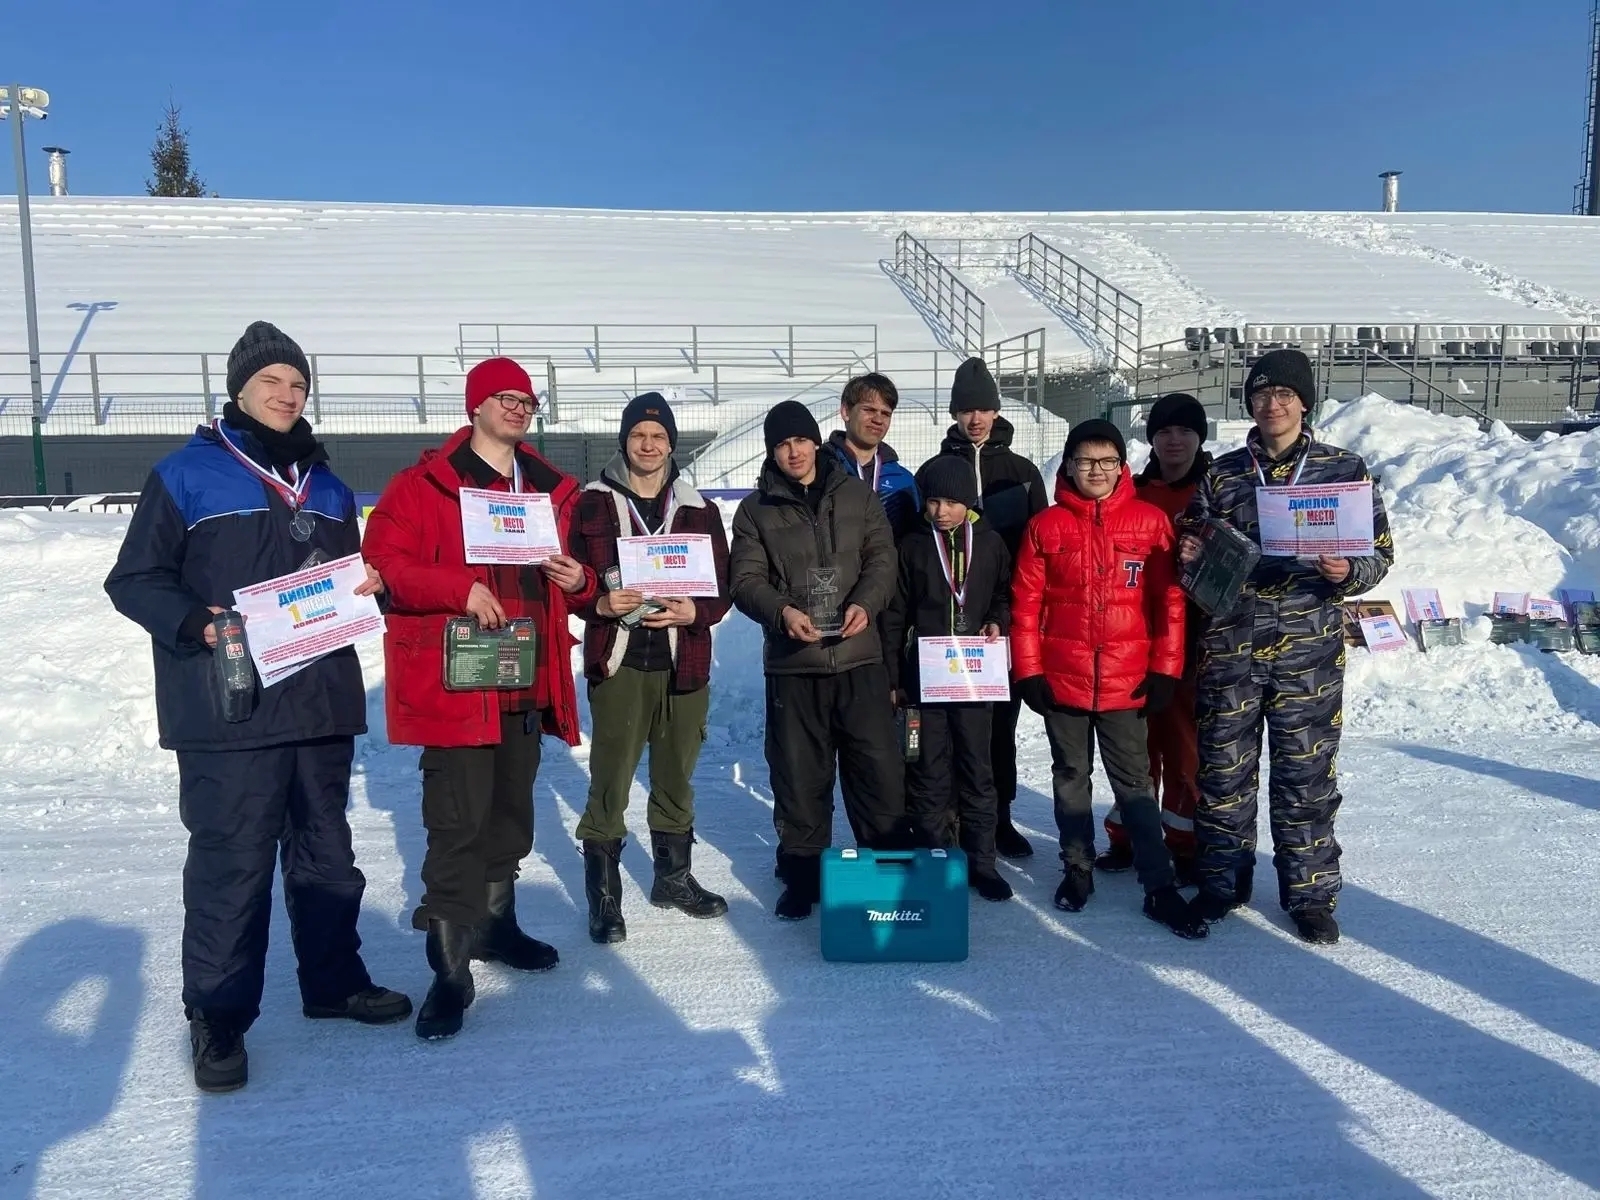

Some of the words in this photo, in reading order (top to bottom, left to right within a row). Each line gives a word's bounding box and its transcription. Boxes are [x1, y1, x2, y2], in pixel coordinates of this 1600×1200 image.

[488, 503, 526, 517] ДИПЛОМ
[1288, 497, 1339, 511] ДИПЛОМ
[492, 516, 502, 532] 2
[503, 516, 524, 529] МЕСТО
[1294, 510, 1304, 527] 2
[1307, 510, 1335, 521] МЕСТО
[647, 545, 688, 556] ДИПЛОМ
[653, 556, 661, 570] 1
[663, 555, 687, 565] МЕСТО
[1123, 559, 1144, 588] T
[278, 578, 334, 608] ДИПЛОМ
[288, 603, 303, 623] 1
[303, 595, 333, 613] МЕСТО
[823, 595, 829, 608] 1
[293, 611, 338, 630] КОМАНДА
[964, 659, 982, 669] ЕСТО
